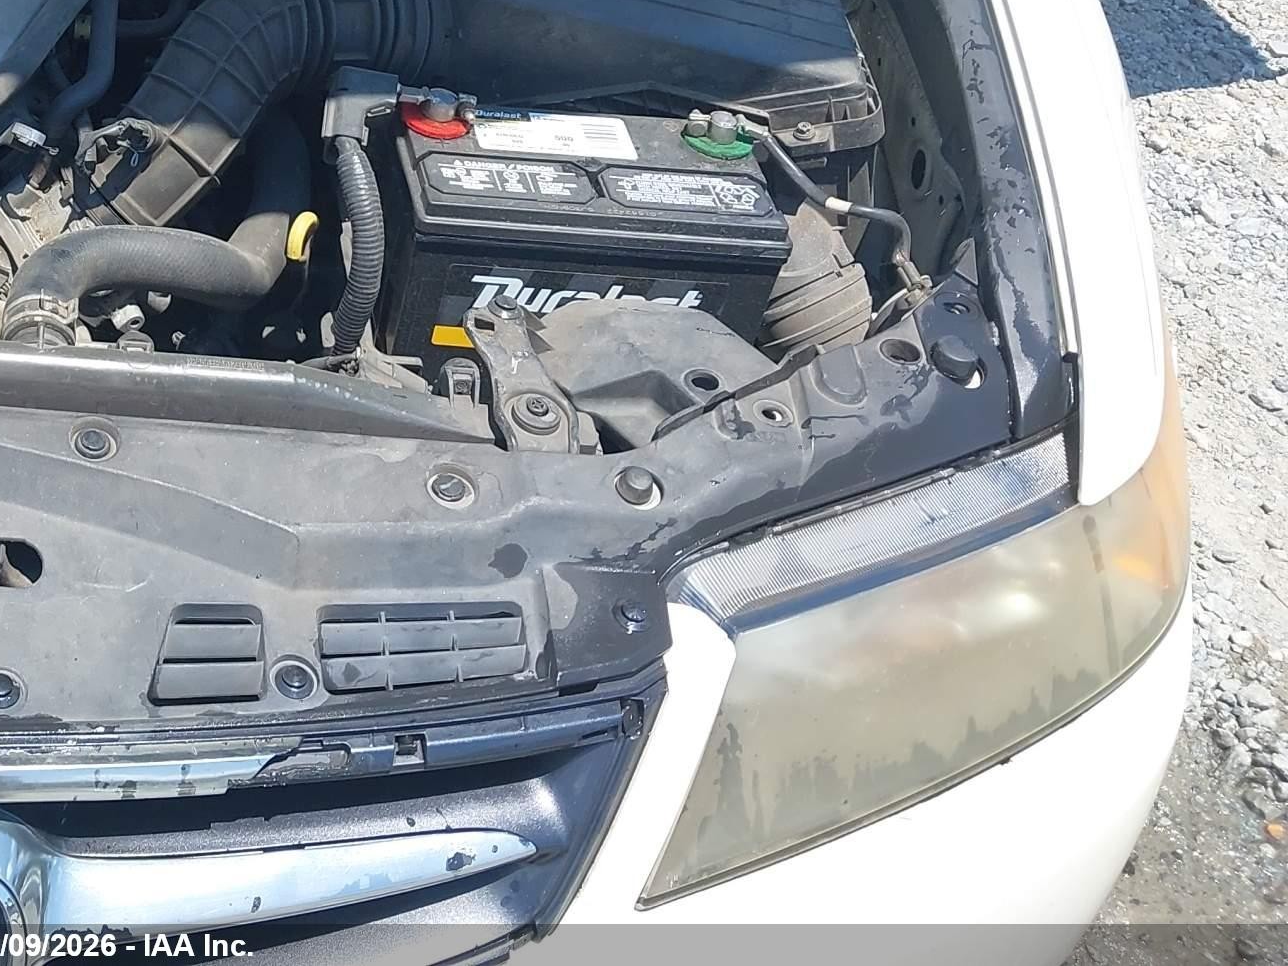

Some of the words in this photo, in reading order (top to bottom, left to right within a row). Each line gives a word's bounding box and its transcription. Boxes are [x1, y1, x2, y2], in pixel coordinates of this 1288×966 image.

[474, 109, 523, 120] Duralast
[465, 160, 507, 171] DANGER
[516, 163, 554, 173] POISON
